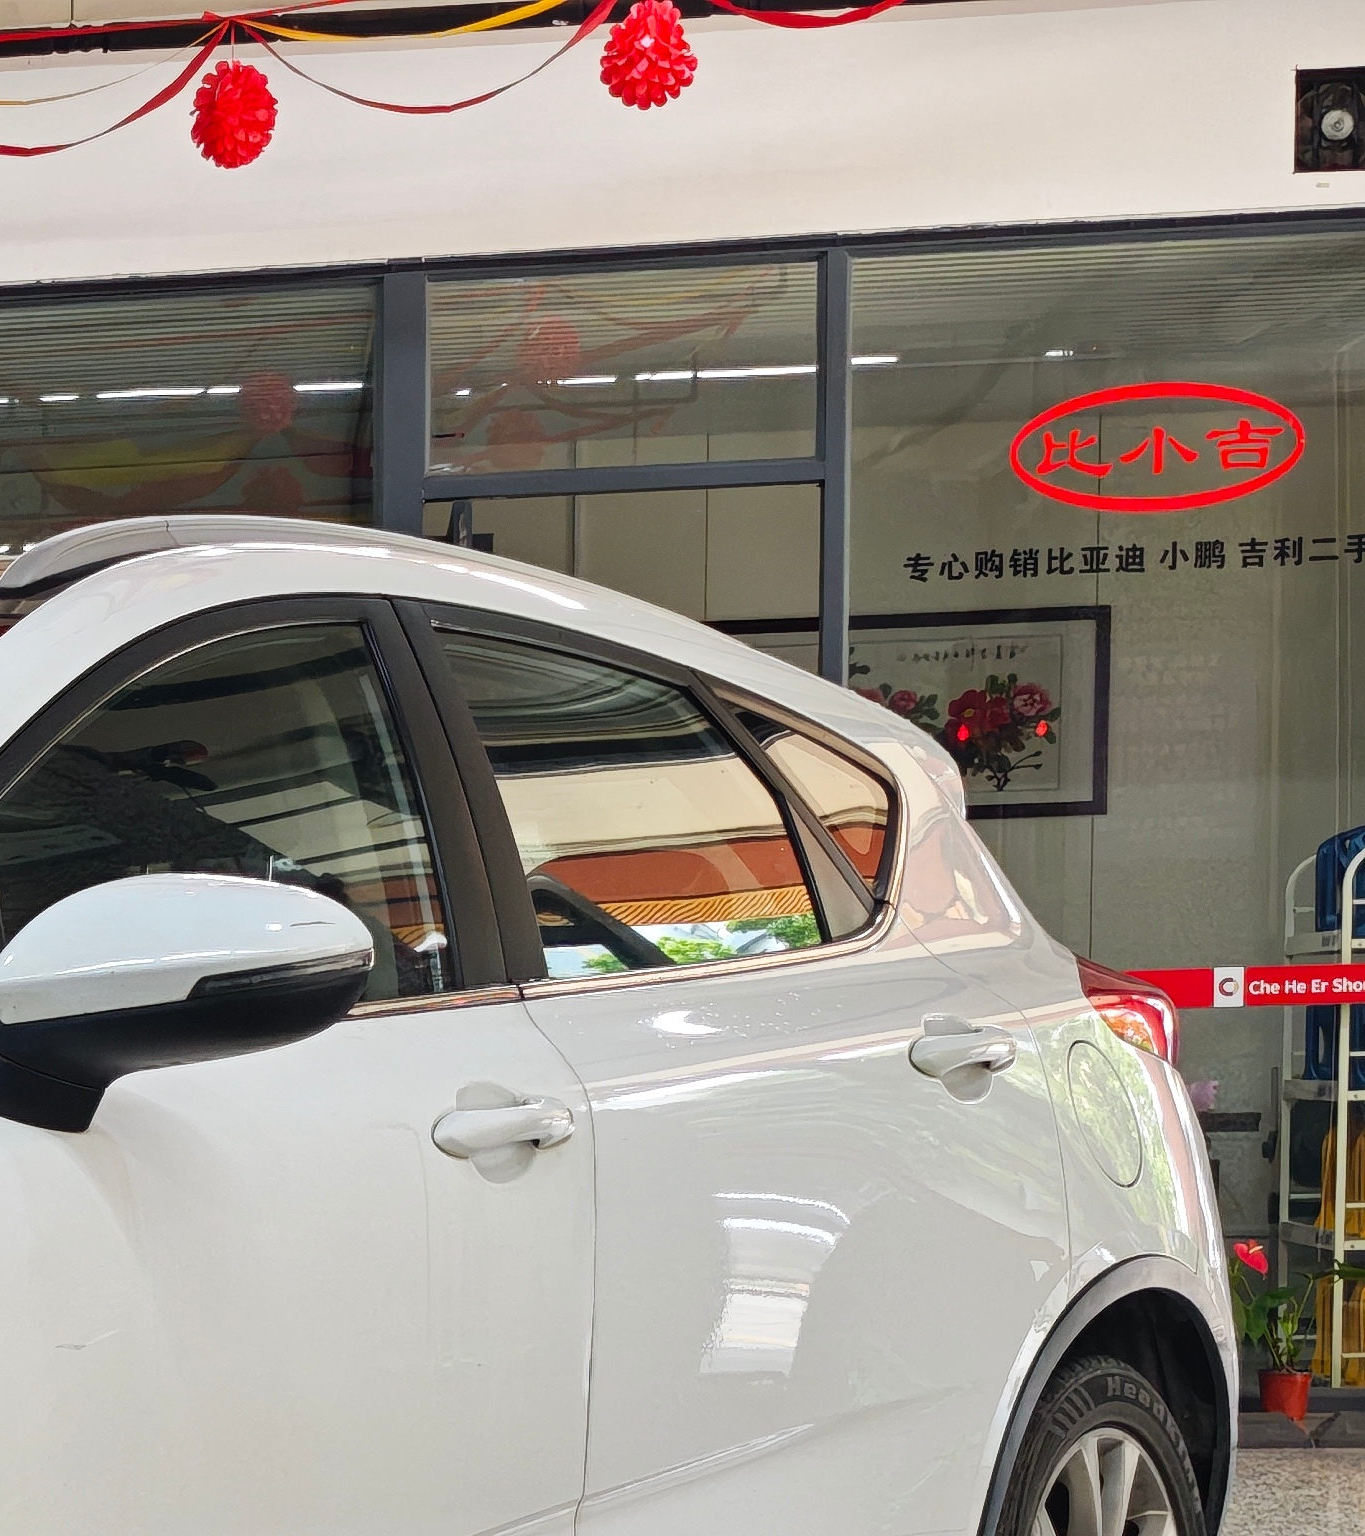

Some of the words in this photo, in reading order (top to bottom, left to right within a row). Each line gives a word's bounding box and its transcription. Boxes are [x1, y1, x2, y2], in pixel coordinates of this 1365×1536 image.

[1035, 418, 1285, 478] 比小吉
[903, 543, 1146, 583] 专心购销比亚迪
[1159, 539, 1226, 570] 小鹏
[1238, 534, 1365, 568] 吉利二手
[1248, 980, 1280, 995] Che
[1284, 979, 1306, 994] He
[1311, 978, 1329, 993] Er
